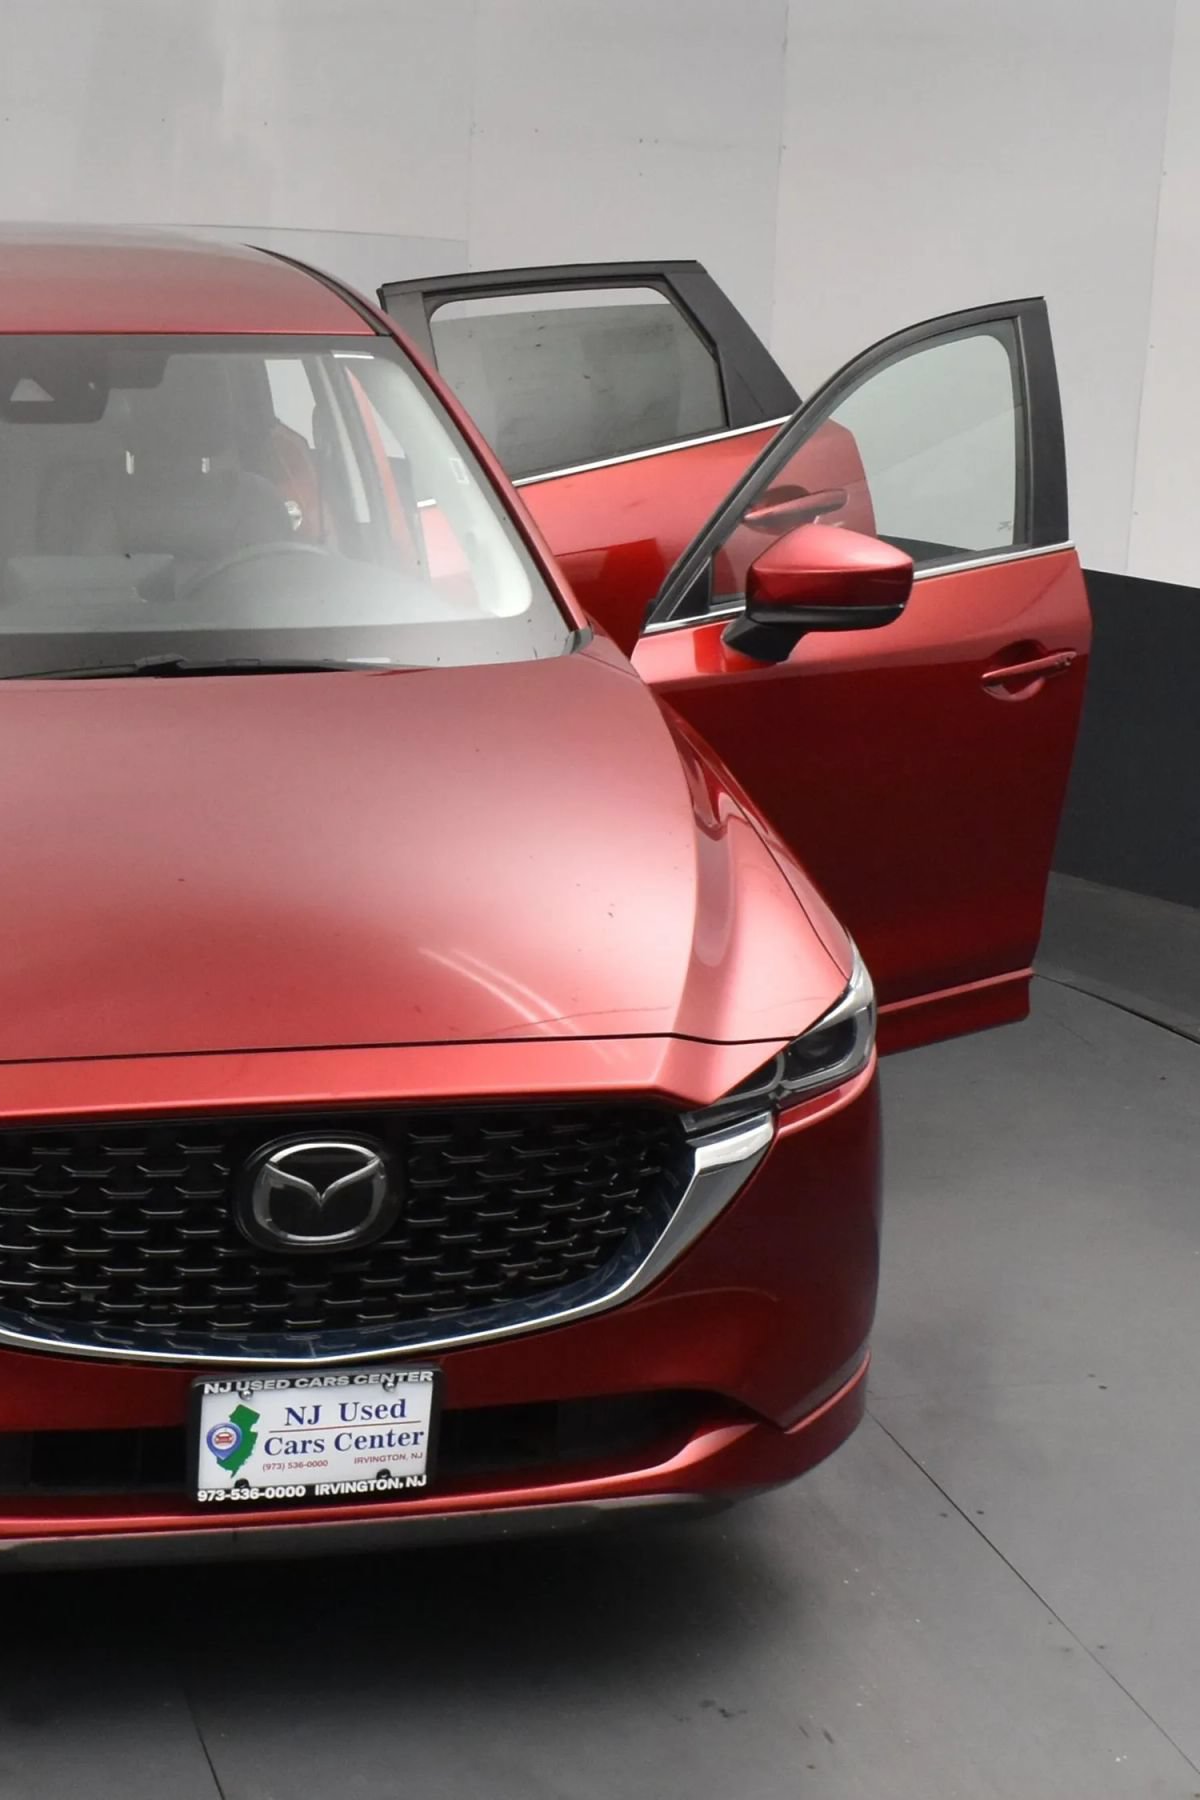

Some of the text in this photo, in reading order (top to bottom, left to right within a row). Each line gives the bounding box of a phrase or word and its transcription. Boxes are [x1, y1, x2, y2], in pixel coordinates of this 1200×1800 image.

[203, 1371, 433, 1394] NJ USED CARS CENTER
[284, 1399, 406, 1426] NJ Used
[264, 1429, 424, 1456] Cars Center
[262, 1459, 328, 1472] (973) 536-0000
[354, 1453, 408, 1465] IRVINGTON,
[197, 1474, 427, 1502] 973-536-0000 IRVINGTON, NJ
